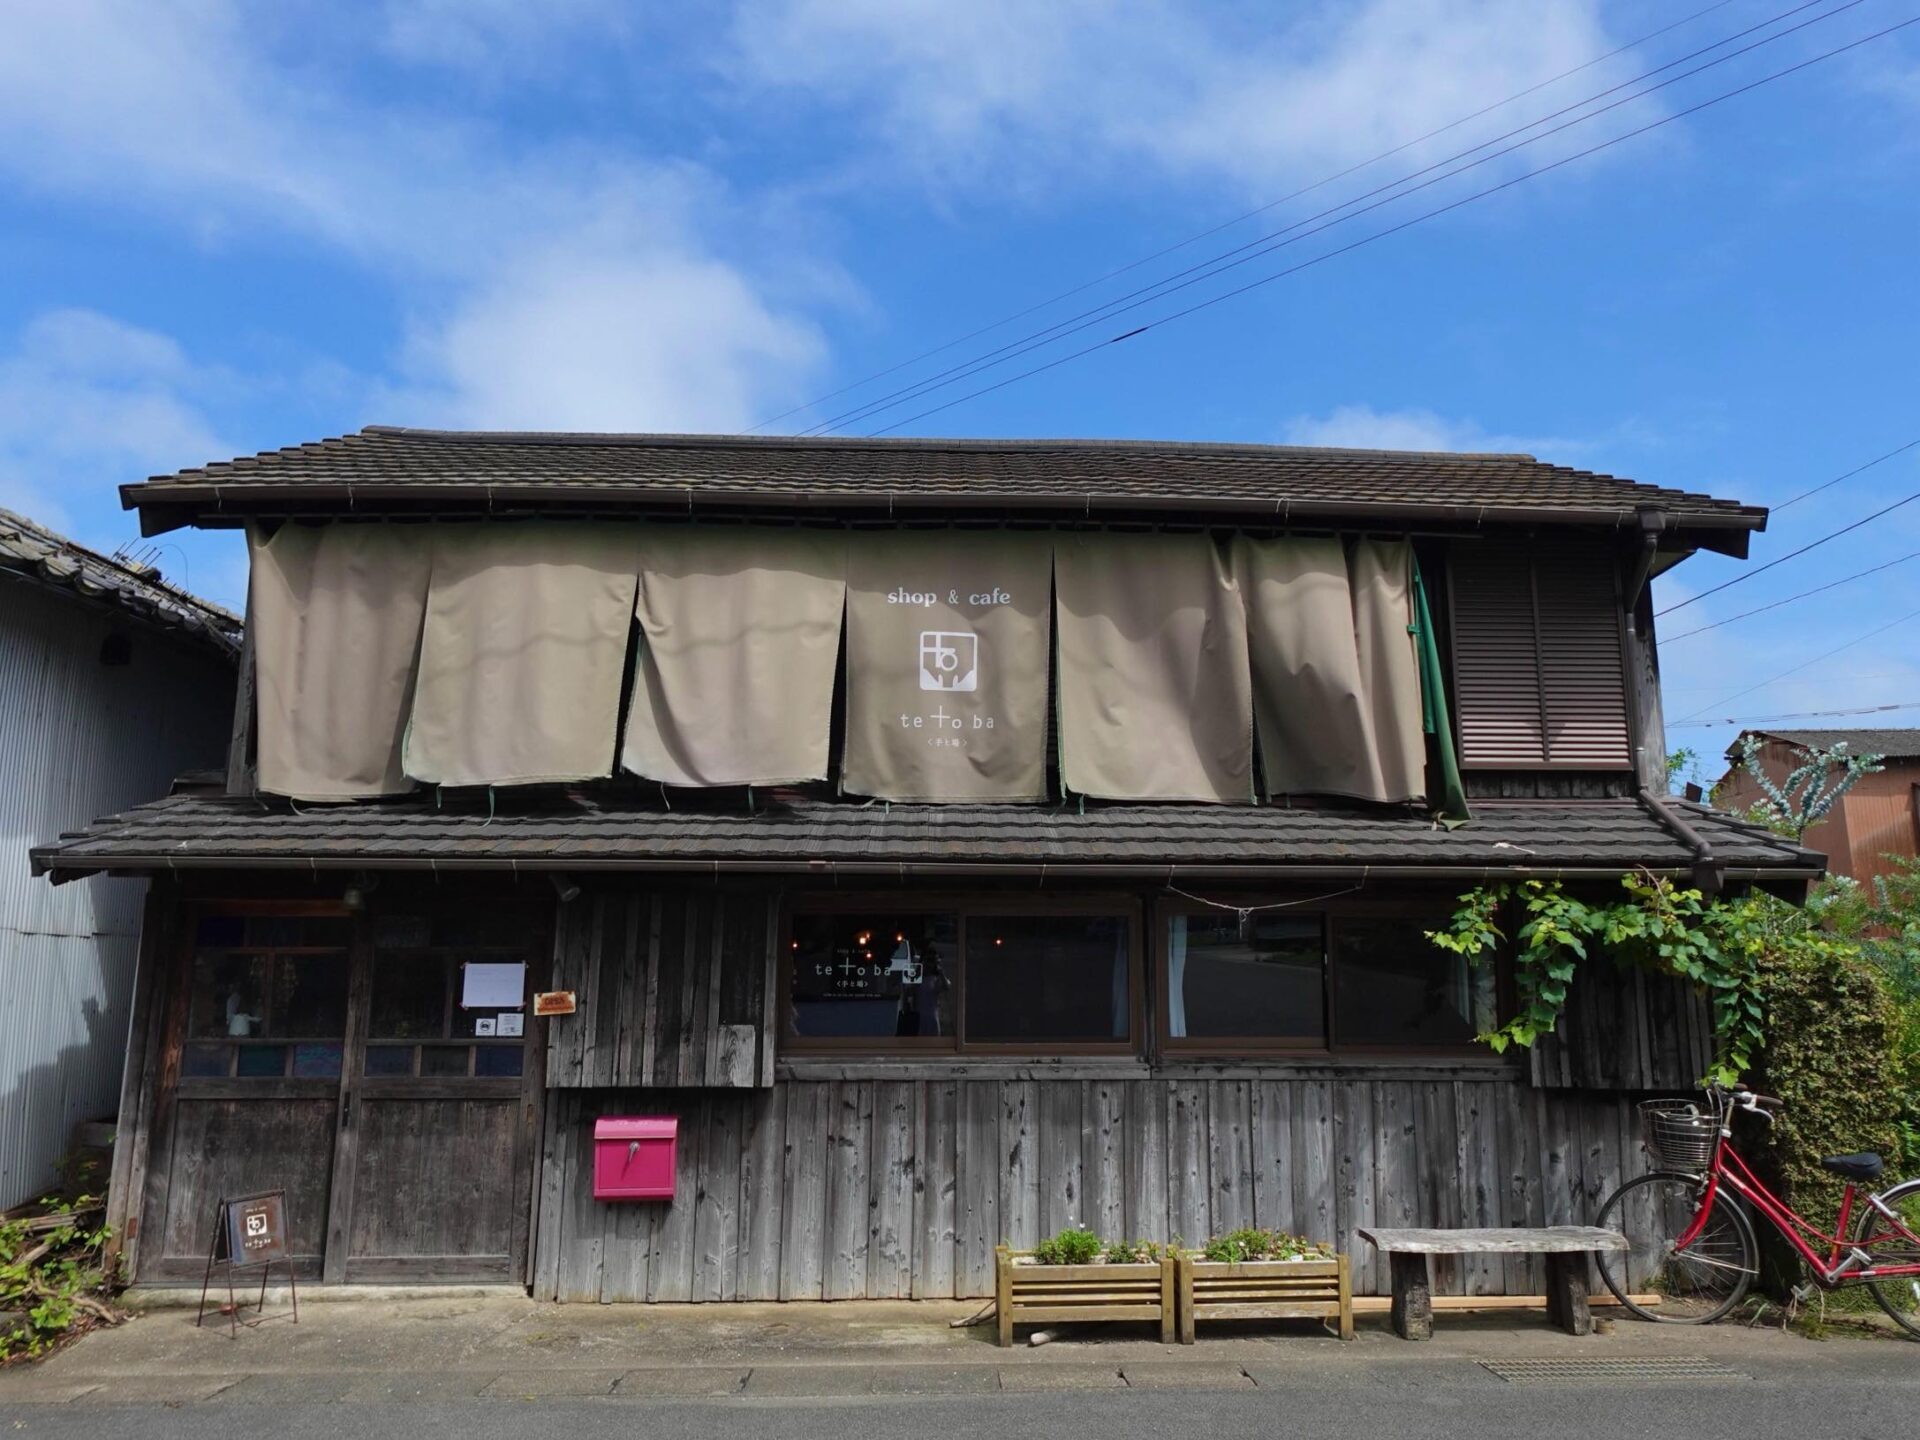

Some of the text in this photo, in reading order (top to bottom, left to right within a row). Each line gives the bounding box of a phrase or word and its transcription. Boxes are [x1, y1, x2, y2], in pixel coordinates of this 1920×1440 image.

[887, 587, 1011, 607] shop & cafe
